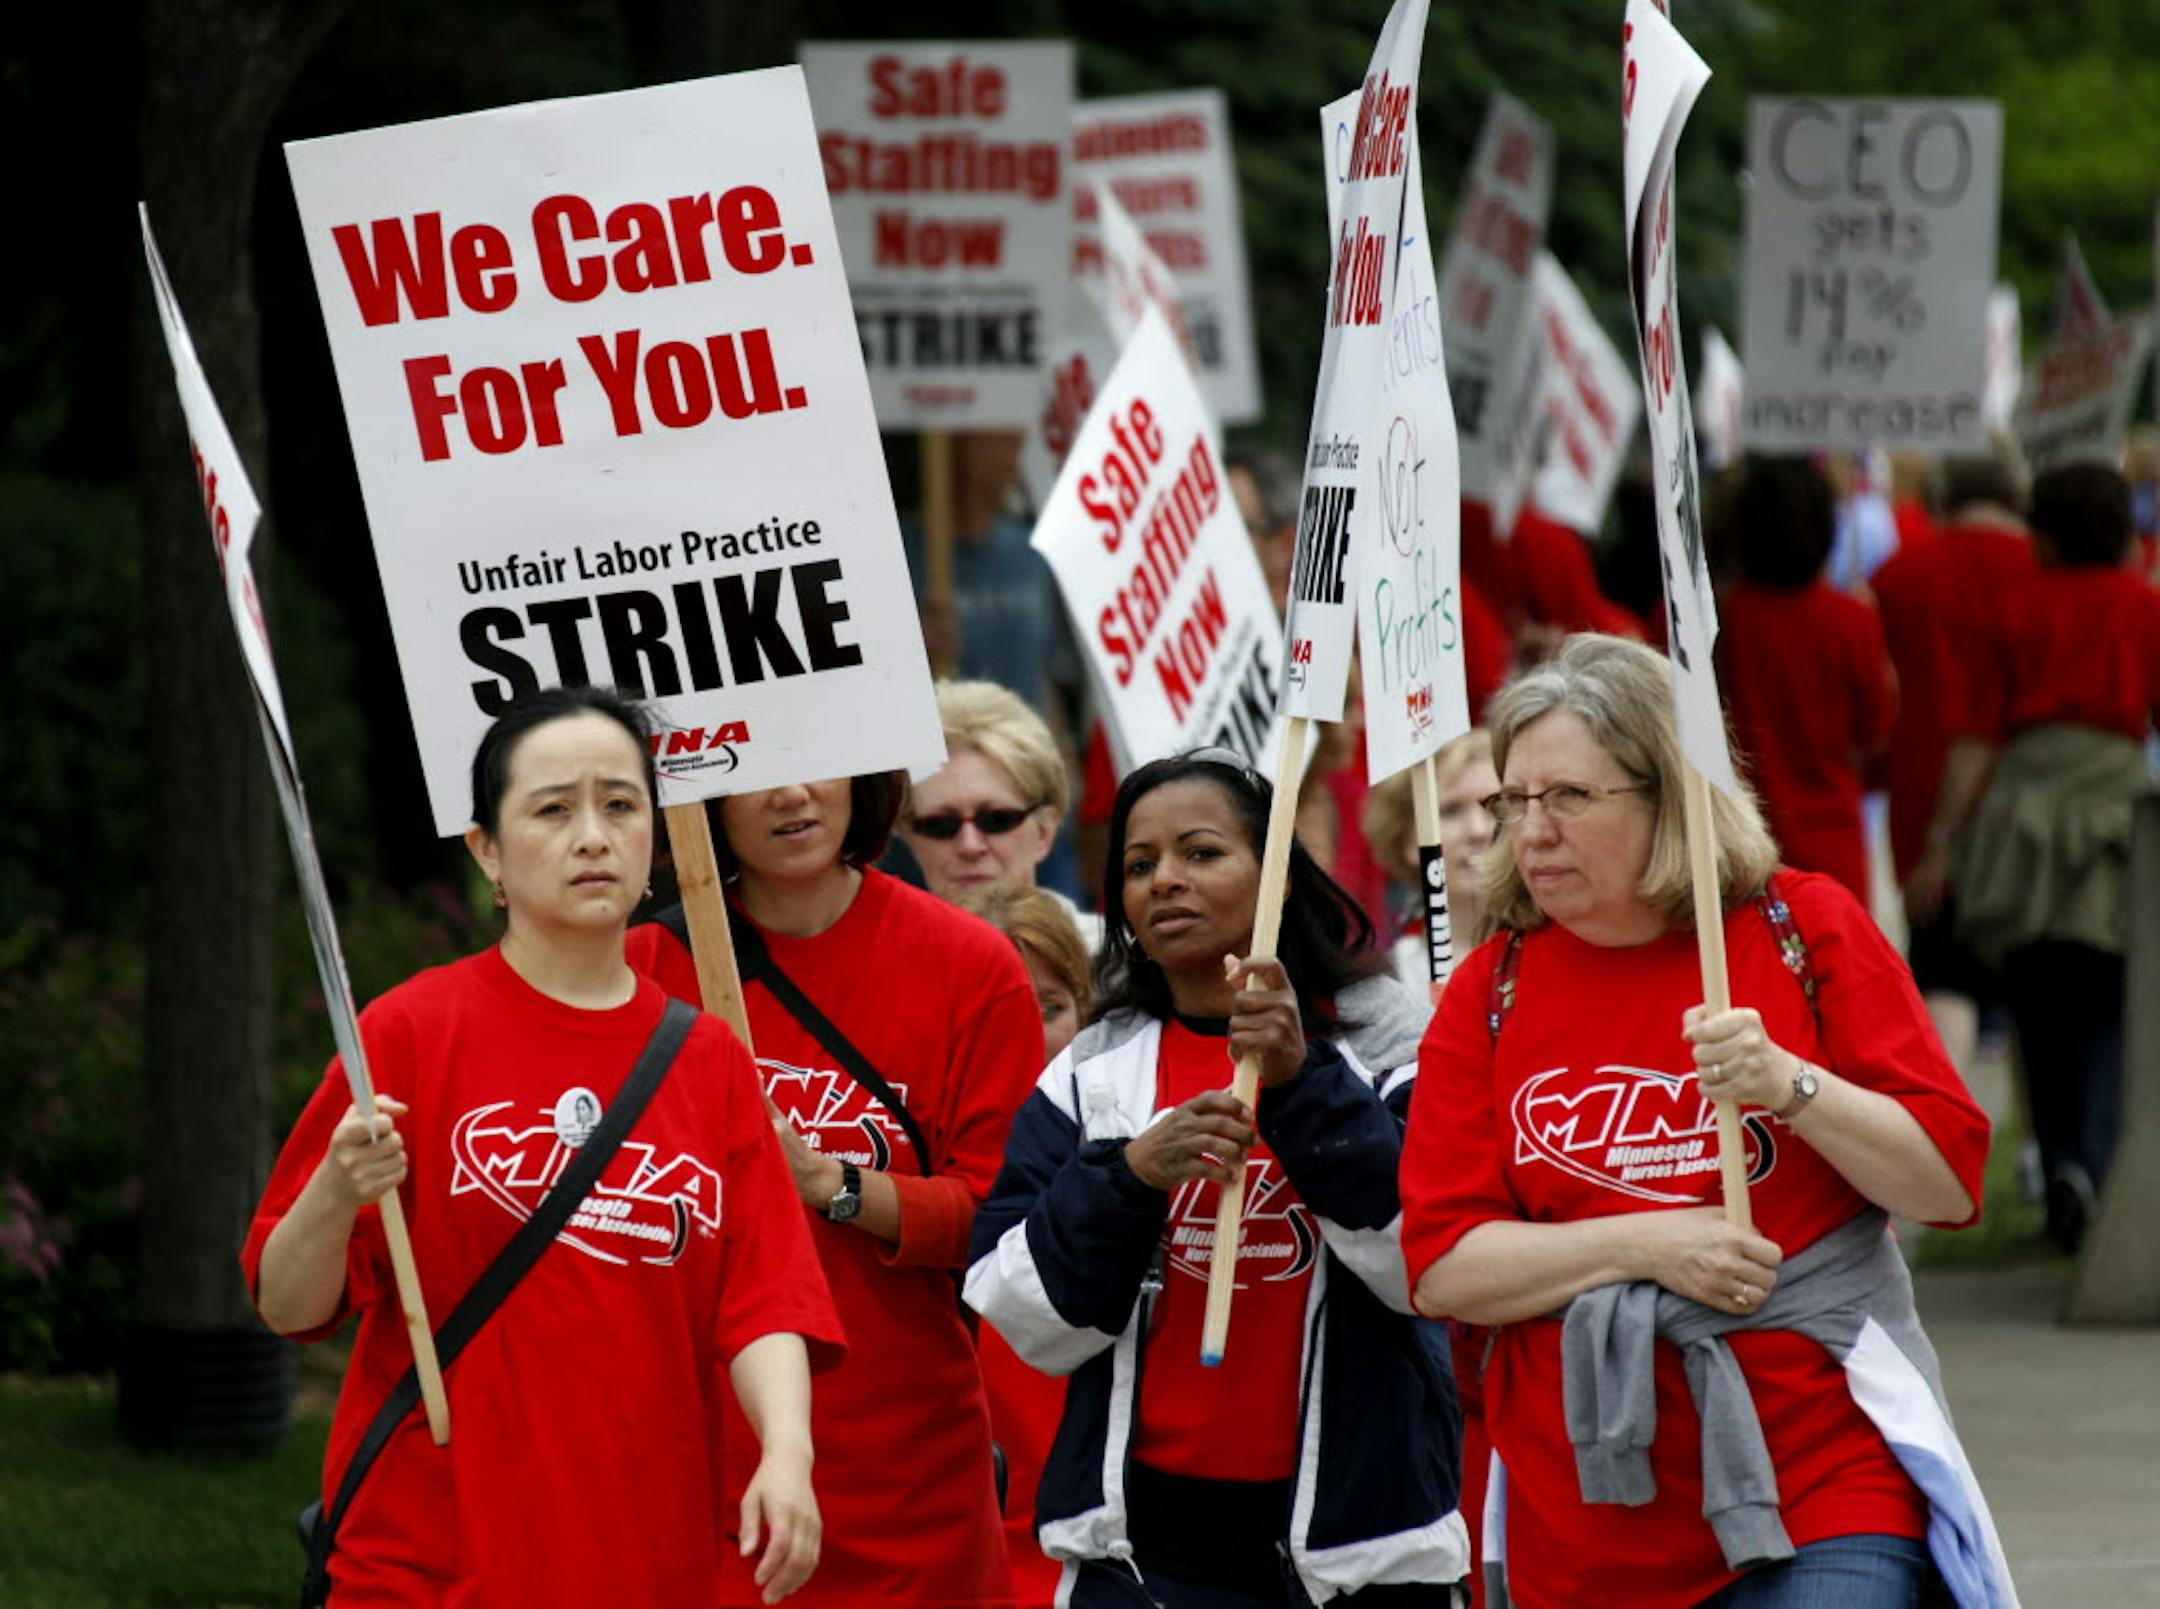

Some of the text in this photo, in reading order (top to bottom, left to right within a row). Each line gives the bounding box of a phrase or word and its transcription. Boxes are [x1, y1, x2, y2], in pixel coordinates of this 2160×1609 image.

[867, 55, 1007, 120] Safe
[819, 132, 1062, 206] Staffing
[1769, 98, 1974, 207] CEO
[331, 184, 814, 328] We Care.
[873, 212, 1005, 268] Now
[403, 327, 809, 464] For You.
[1077, 397, 1164, 554] Safe
[458, 516, 823, 595] Unfair Labor Practice
[1098, 433, 1220, 688] Staffing
[459, 558, 864, 719] STRIKE
[1153, 566, 1228, 725] Now
[1605, 1140, 1706, 1168] Minnesota
[1620, 1163, 1674, 1182] Nurses
